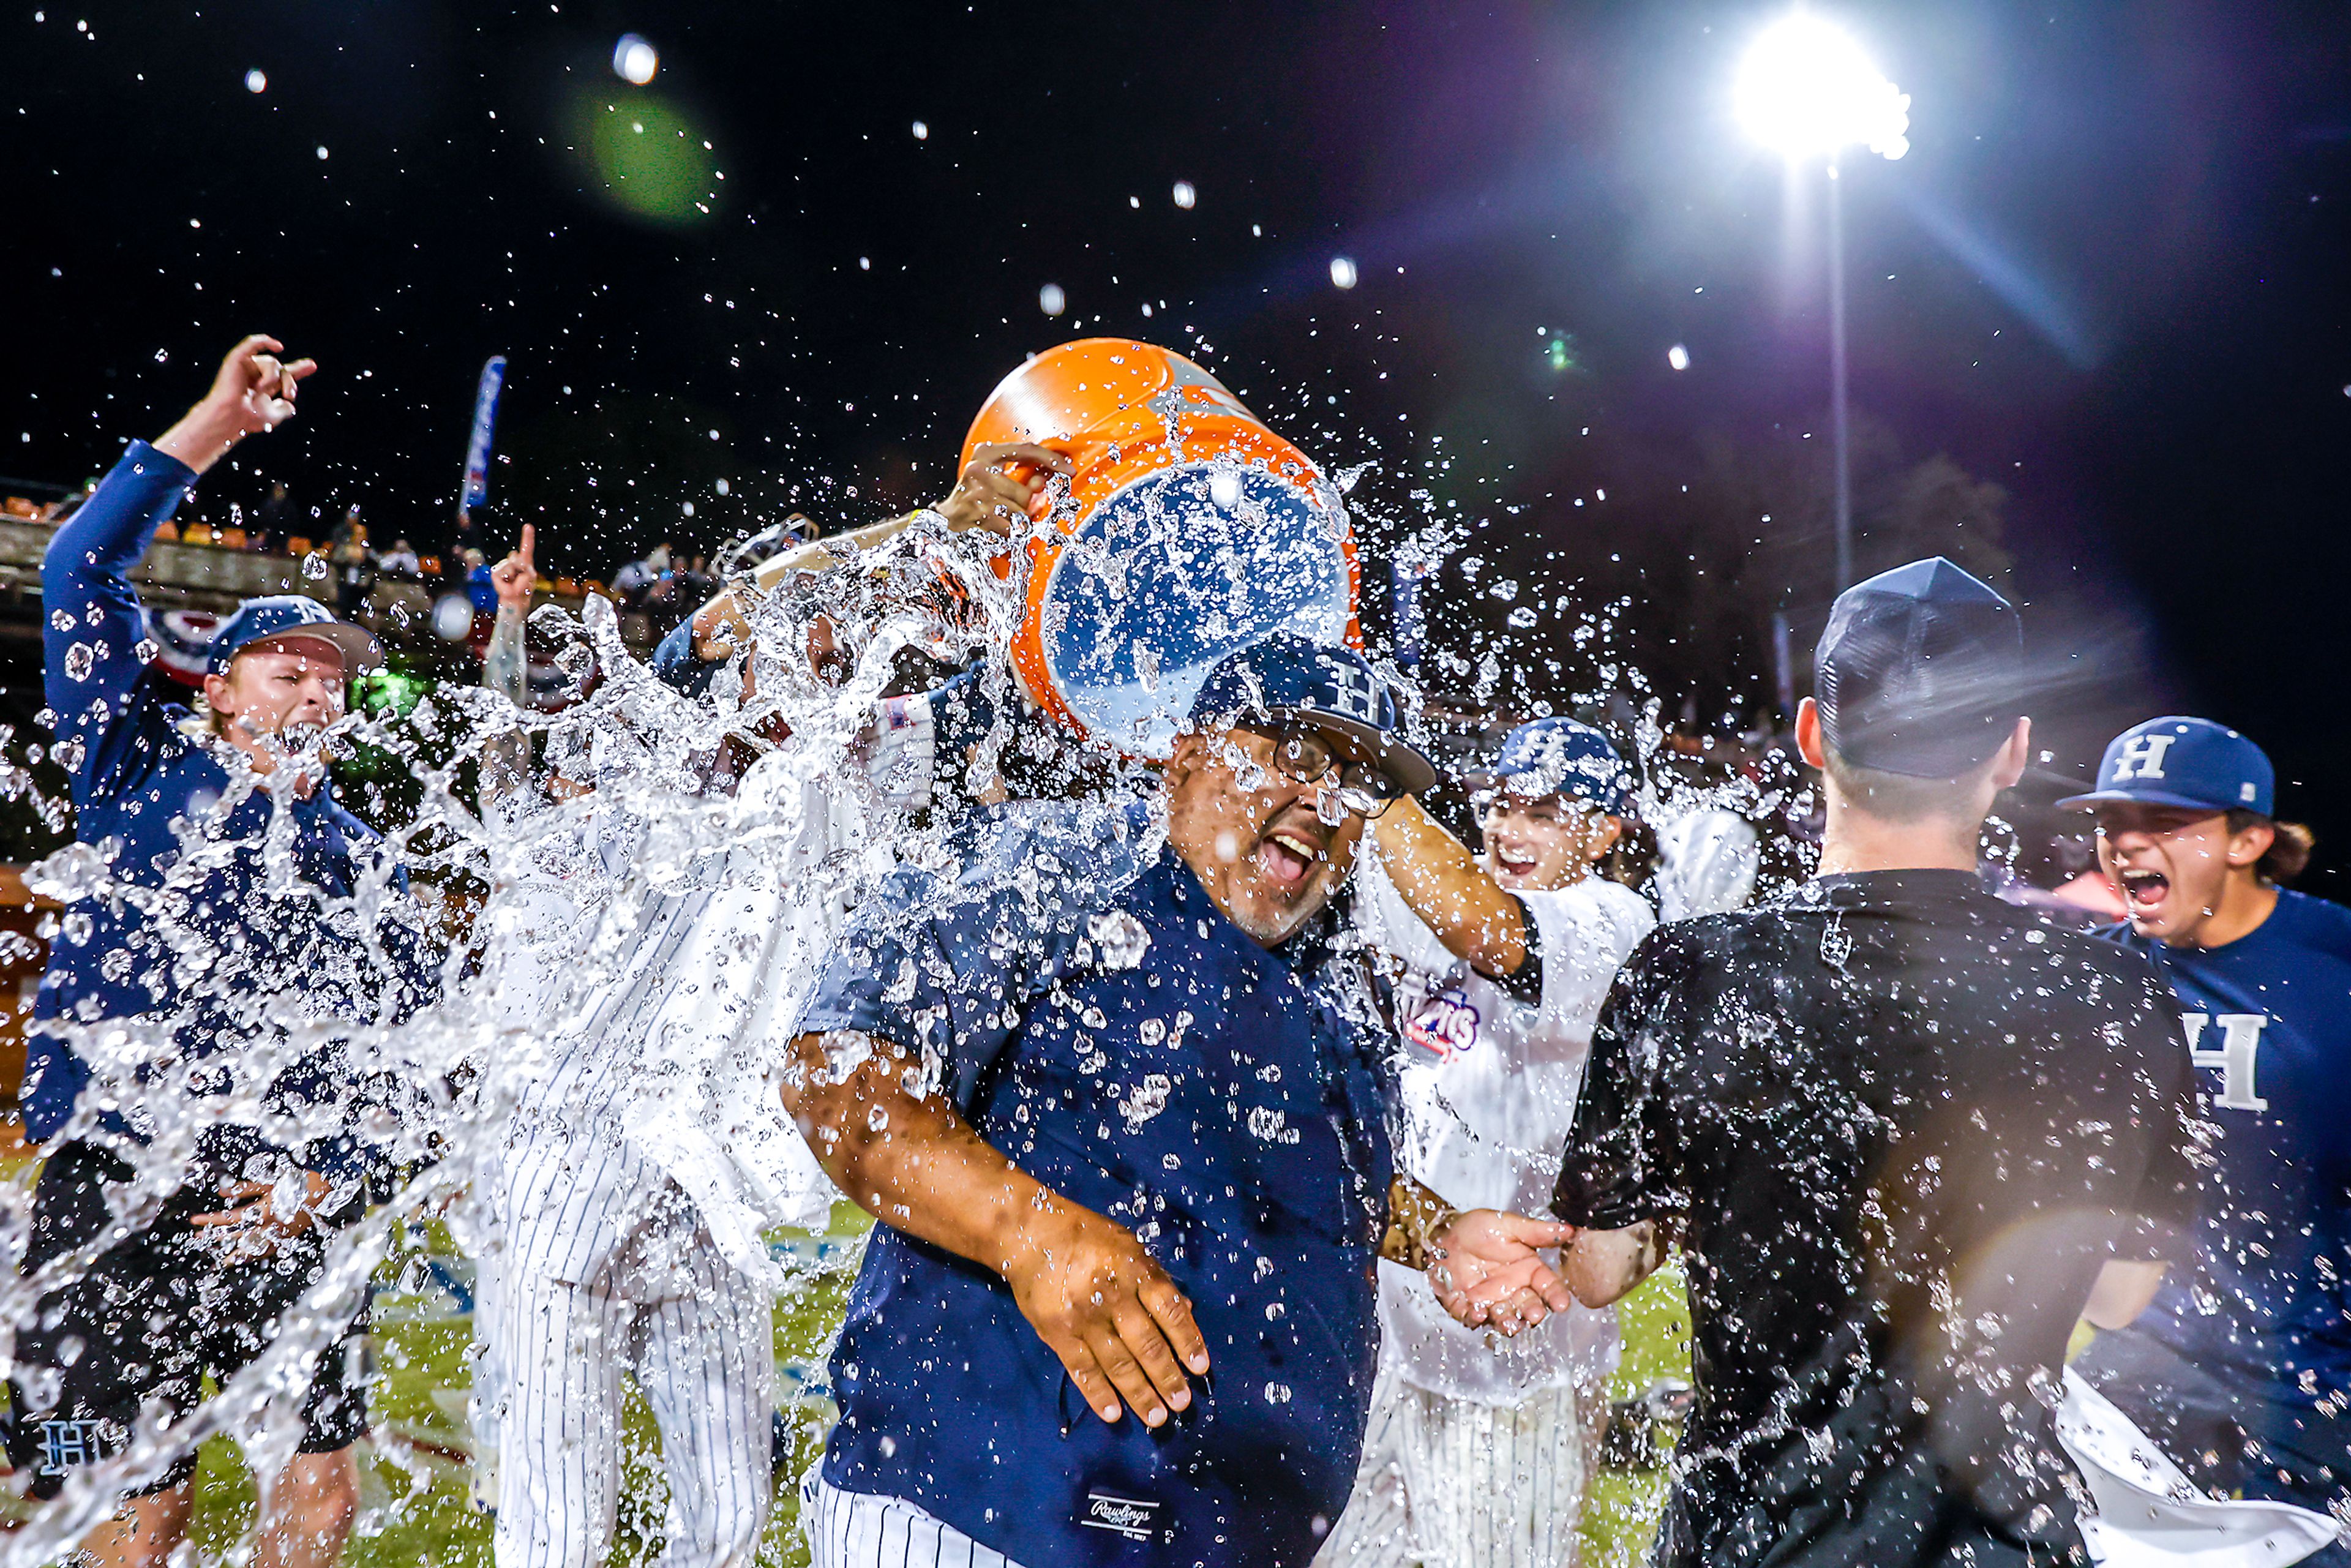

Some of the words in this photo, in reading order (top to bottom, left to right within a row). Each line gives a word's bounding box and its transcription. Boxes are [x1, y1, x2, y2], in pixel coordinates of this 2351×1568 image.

[1325, 661, 1387, 724] H
[1507, 727, 1572, 767] H
[2112, 734, 2176, 783] H
[2181, 1012, 2268, 1111] H
[36, 1419, 105, 1476] H
[1090, 1500, 1151, 1526] Rawlings
